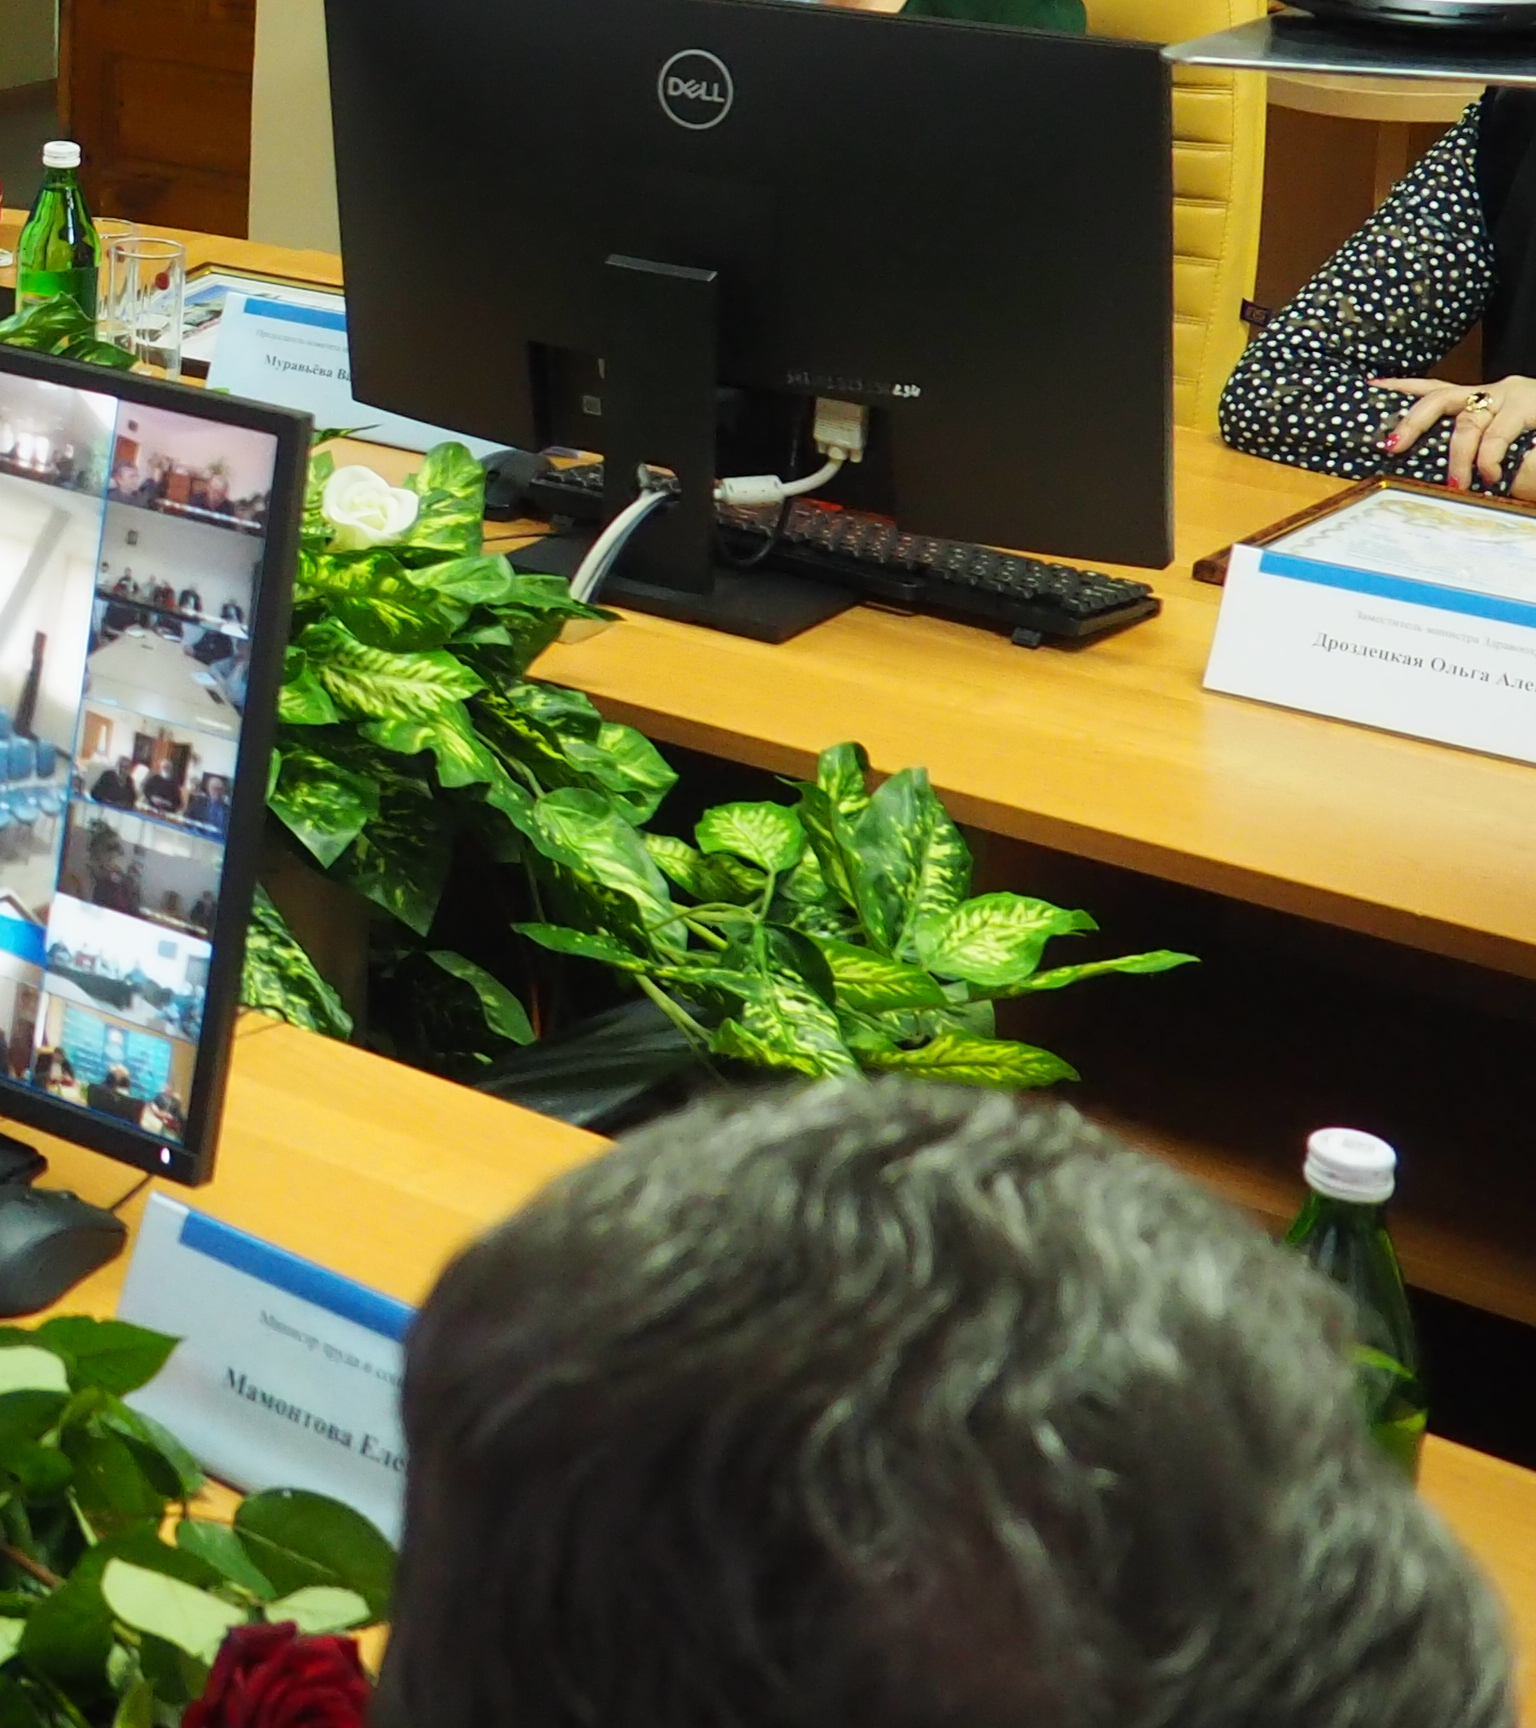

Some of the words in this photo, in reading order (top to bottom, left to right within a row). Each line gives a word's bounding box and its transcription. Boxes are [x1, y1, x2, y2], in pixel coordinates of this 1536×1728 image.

[667, 76, 725, 104] DELL
[265, 354, 333, 378] Муравьёва
[1312, 631, 1423, 670] Дроздецкая
[1430, 656, 1490, 684] Ольга
[226, 1368, 352, 1449] Мамонтова
